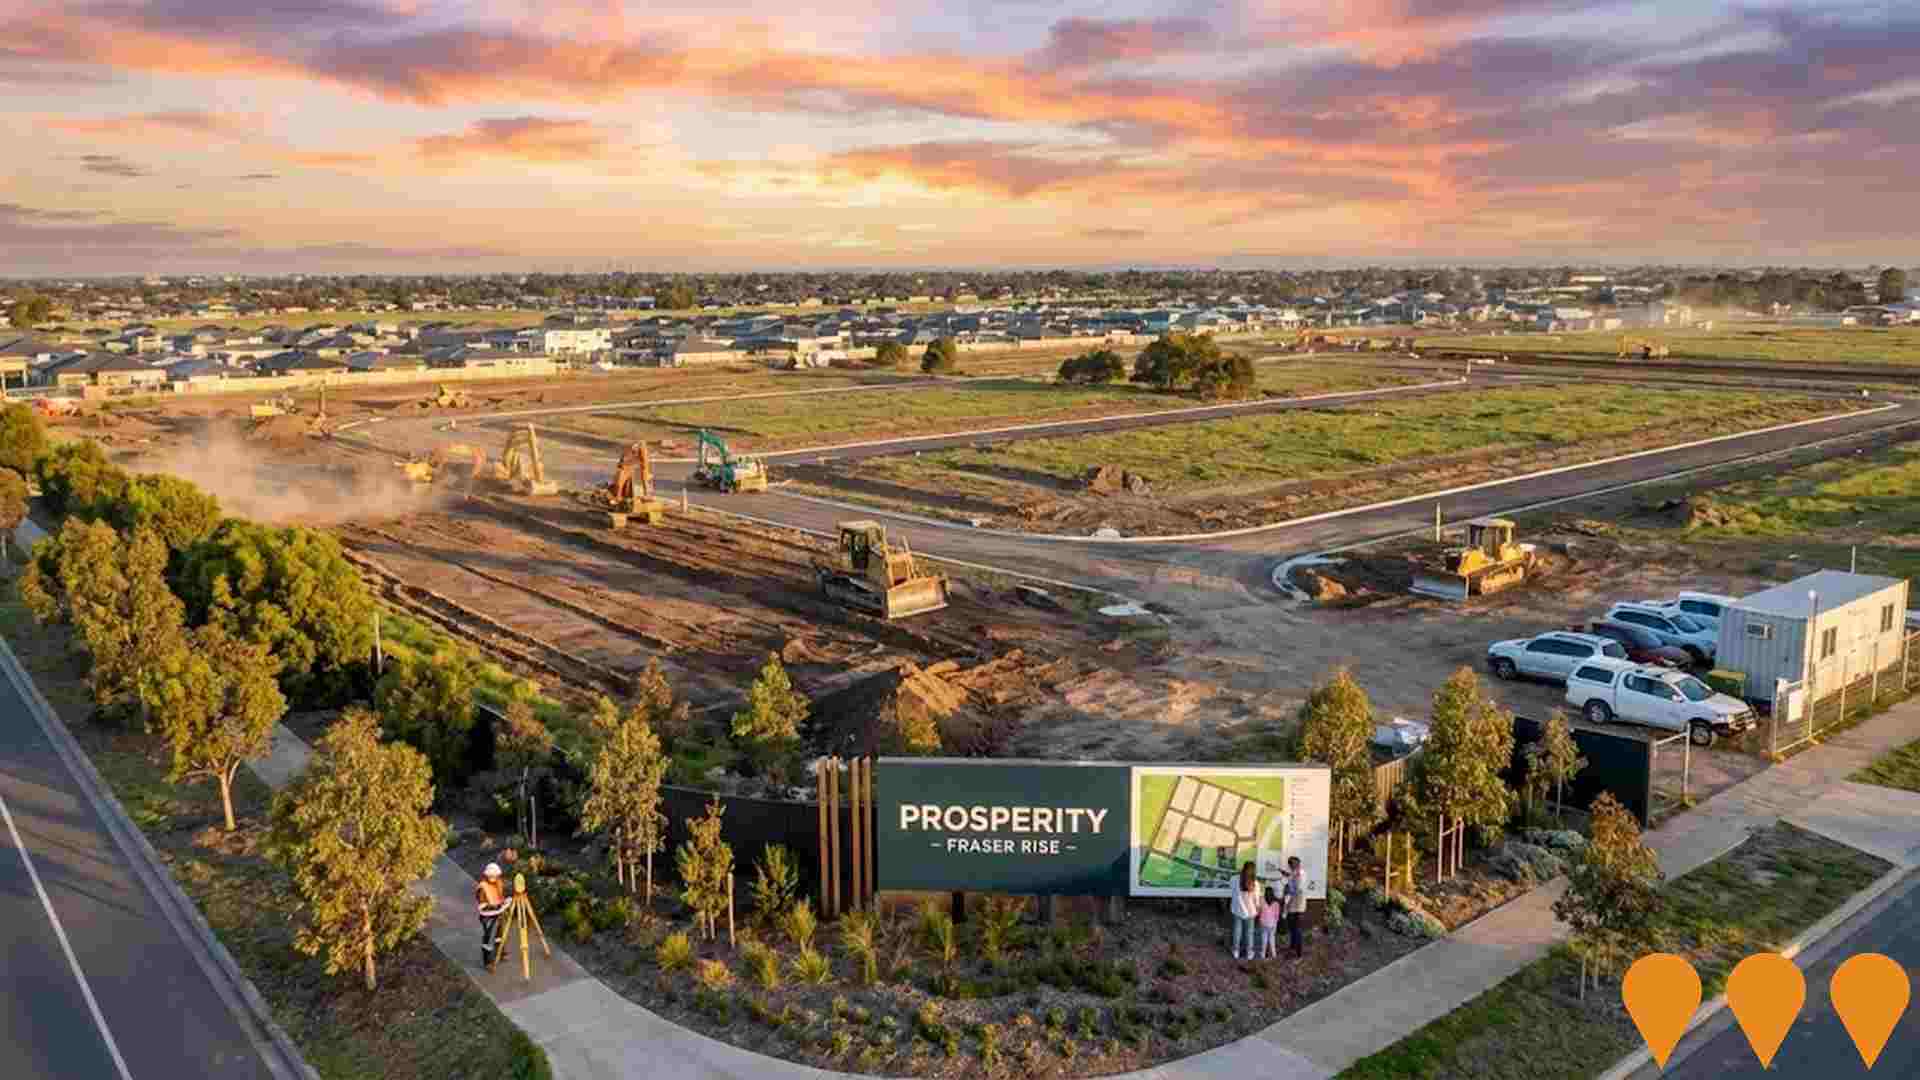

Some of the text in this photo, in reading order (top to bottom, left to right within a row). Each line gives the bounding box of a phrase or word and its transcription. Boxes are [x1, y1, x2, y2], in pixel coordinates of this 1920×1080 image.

[900, 804, 1109, 833] PROSPERITY
[946, 838, 1060, 854] FRASER RISE
